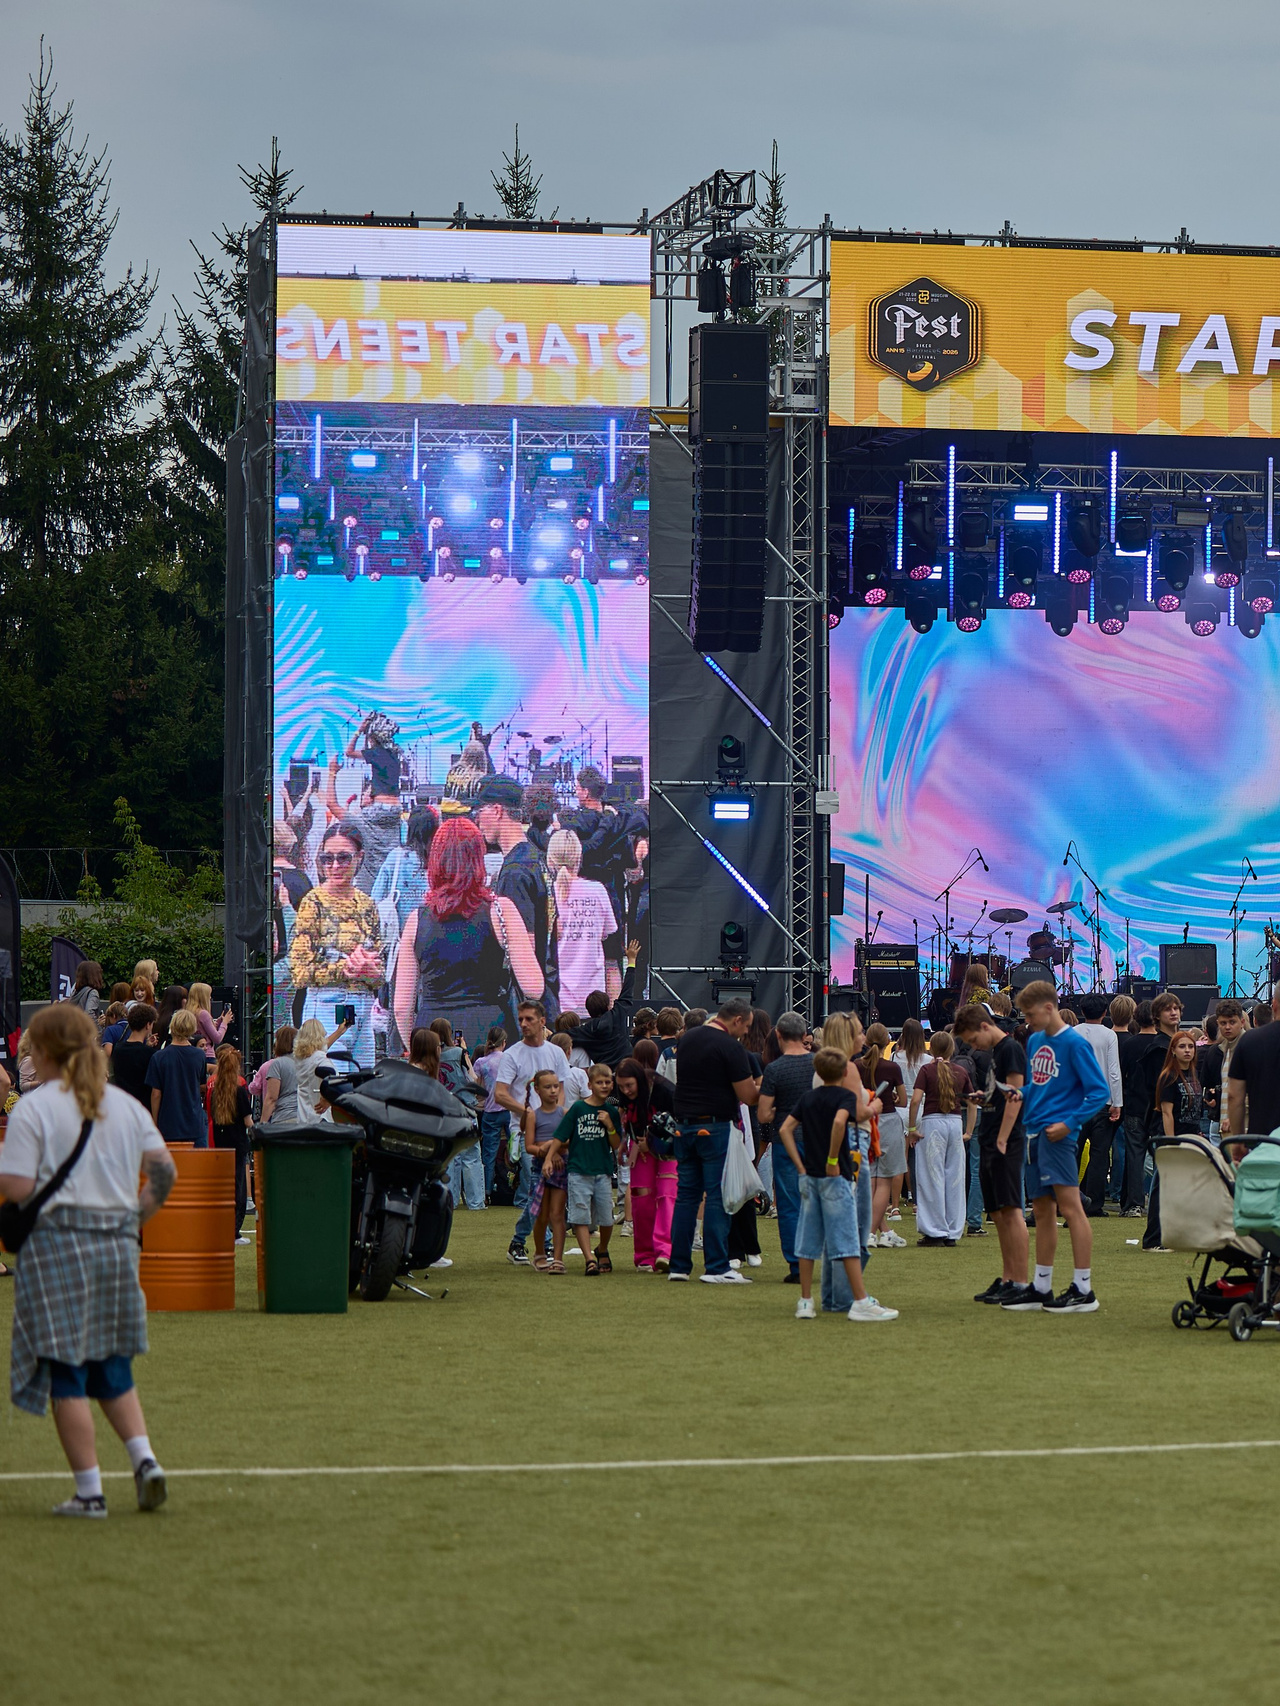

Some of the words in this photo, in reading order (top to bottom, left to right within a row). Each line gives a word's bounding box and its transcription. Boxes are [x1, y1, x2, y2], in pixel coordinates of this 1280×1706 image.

[885, 304, 962, 344] Fest
[577, 1114, 595, 1124] SUPER
[577, 1123, 605, 1137] Boxing
